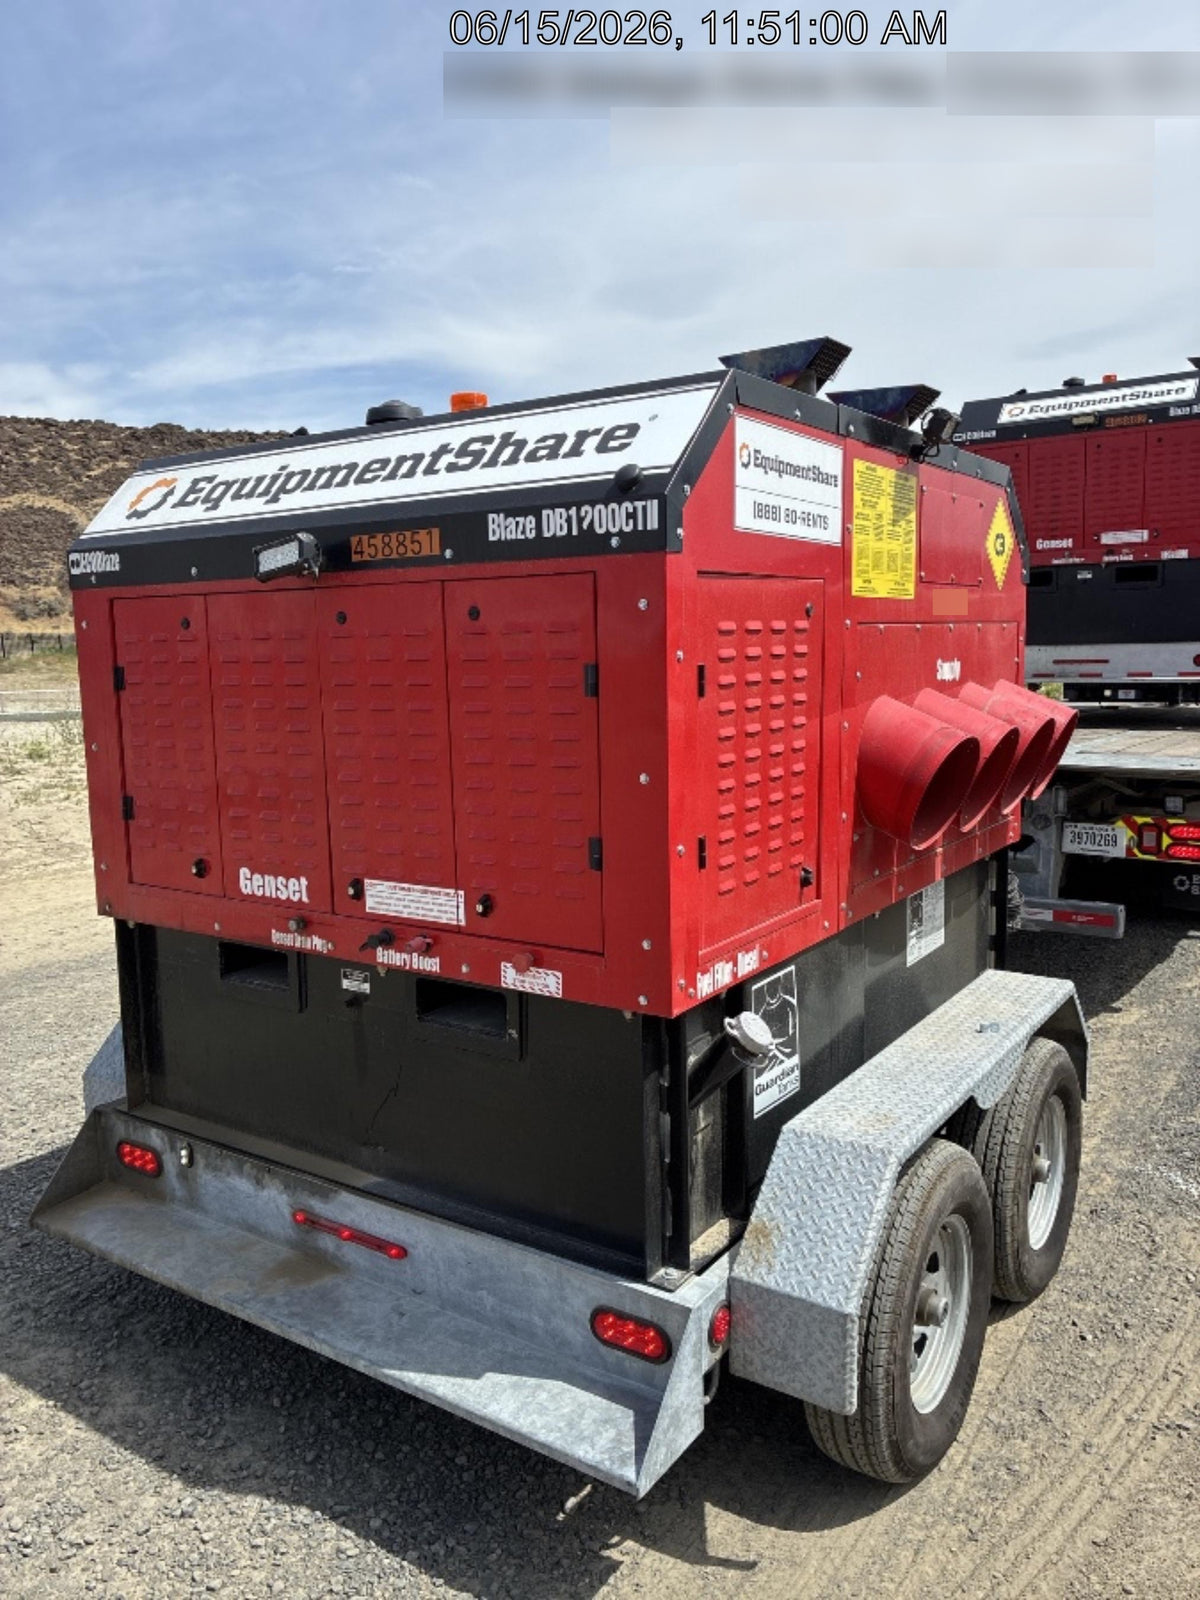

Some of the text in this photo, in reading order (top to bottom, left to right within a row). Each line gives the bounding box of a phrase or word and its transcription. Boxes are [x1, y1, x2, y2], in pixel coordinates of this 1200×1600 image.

[1028, 386, 1187, 416] EquipmentShare
[170, 421, 642, 512] EquipmentShare
[753, 447, 839, 488] EquipmentShare
[487, 513, 536, 542] Blaze
[353, 530, 434, 559] 458851
[1069, 830, 1118, 848] 3970269
[239, 866, 309, 904] Genset
[376, 946, 440, 974] Battery Boost
[696, 966, 714, 1000] Fuel
[756, 1063, 799, 1096] Guardian
